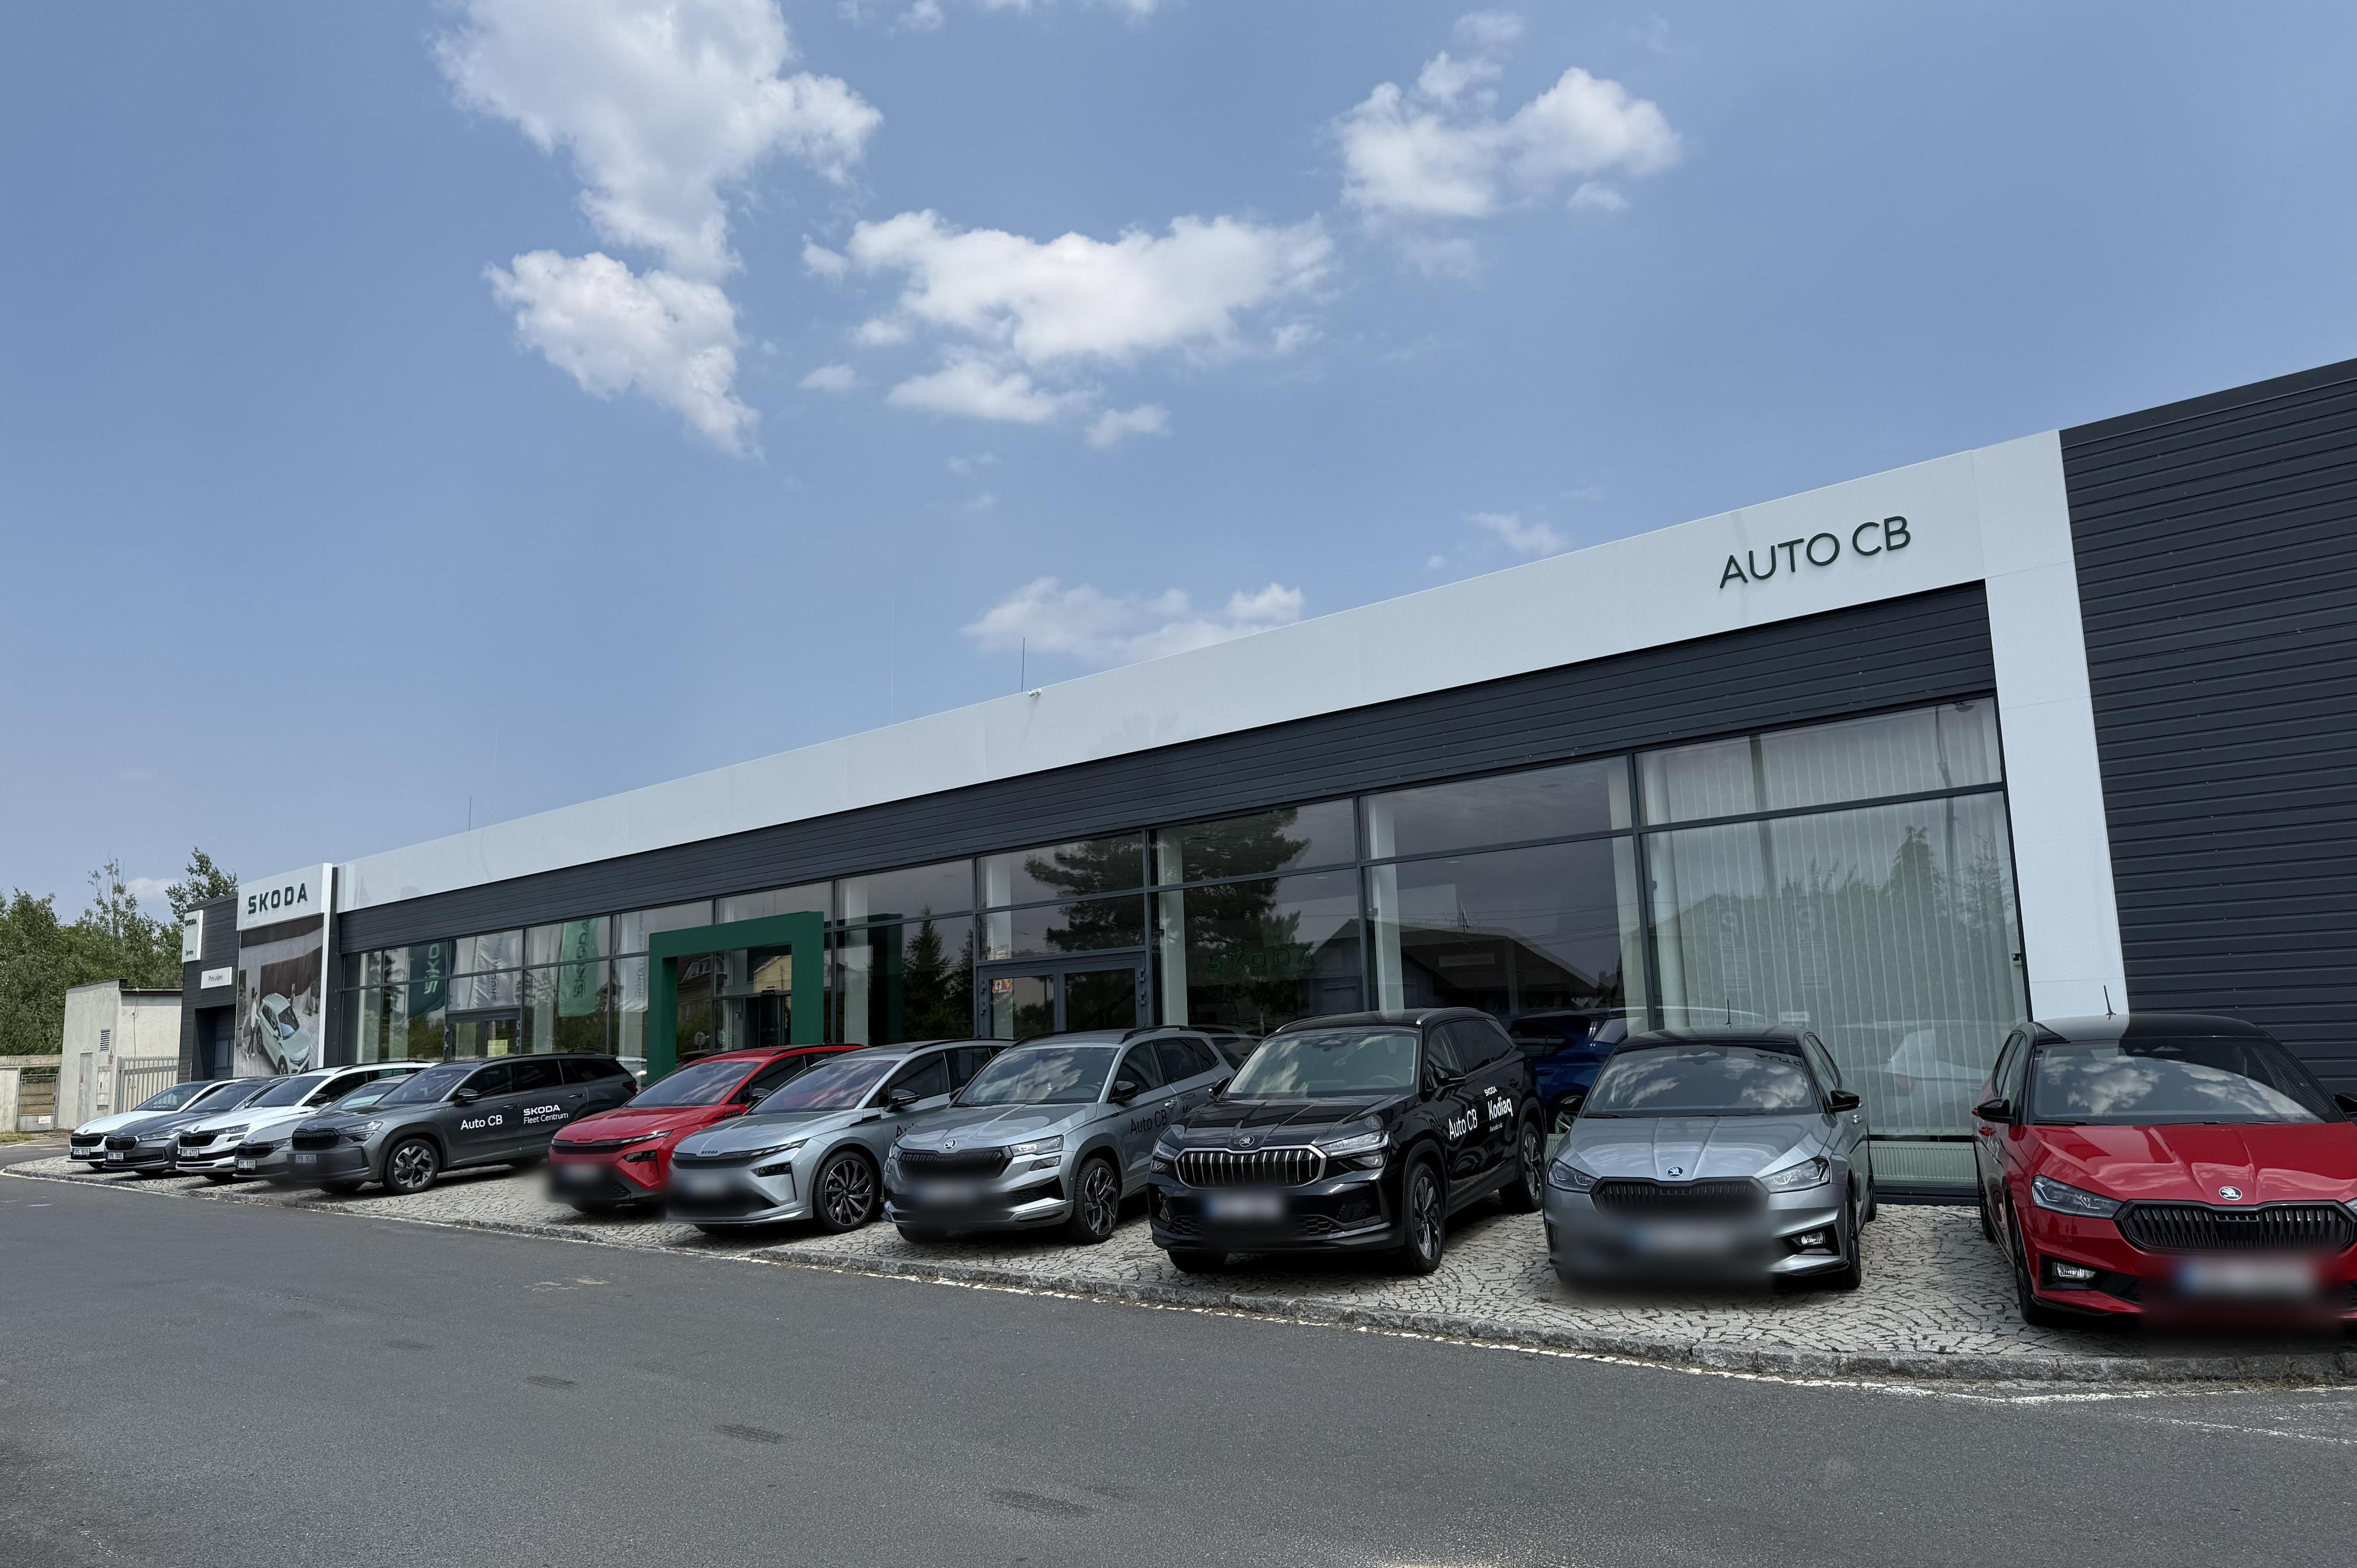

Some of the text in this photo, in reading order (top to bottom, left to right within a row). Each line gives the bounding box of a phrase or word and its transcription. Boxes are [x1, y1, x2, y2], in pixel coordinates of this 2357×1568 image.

[1719, 516, 1911, 589] AUTO CB
[523, 1112, 569, 1124] Fleet Centrum
[1487, 1096, 1513, 1121] Kodiaq
[460, 1114, 503, 1130] Auto CB
[1130, 1110, 1167, 1135] Auto CB
[1448, 1117, 1467, 1140] Auto
[1467, 1108, 1478, 1131] CB
